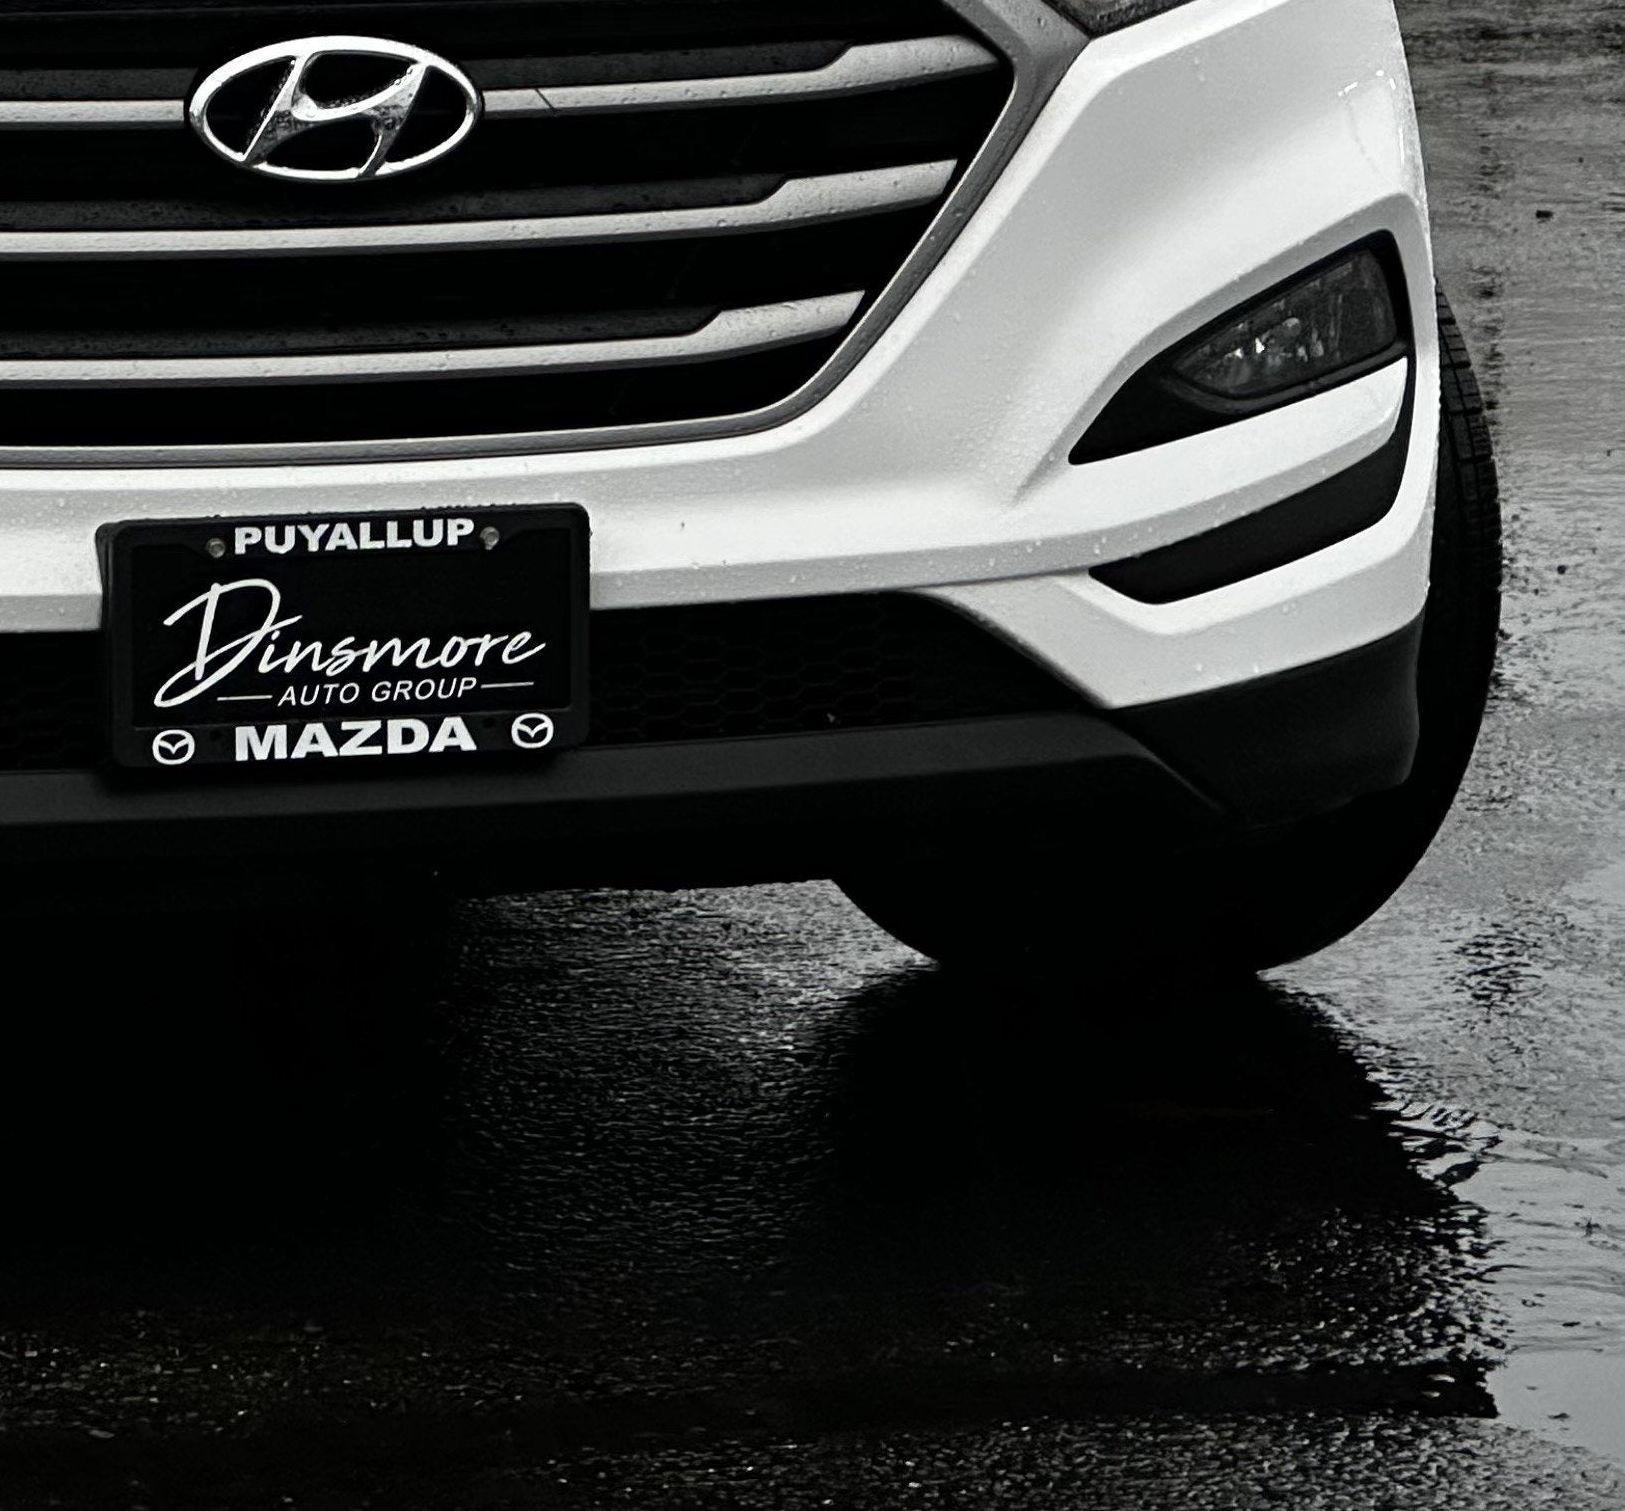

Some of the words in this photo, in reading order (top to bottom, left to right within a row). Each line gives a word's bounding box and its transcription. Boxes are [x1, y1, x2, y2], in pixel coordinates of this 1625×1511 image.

[234, 518, 475, 555] PUYALLUP
[153, 578, 546, 708] Dinsmore
[277, 682, 360, 707] AUTO
[371, 676, 477, 703] GROUP
[235, 716, 477, 762] MAZDA
